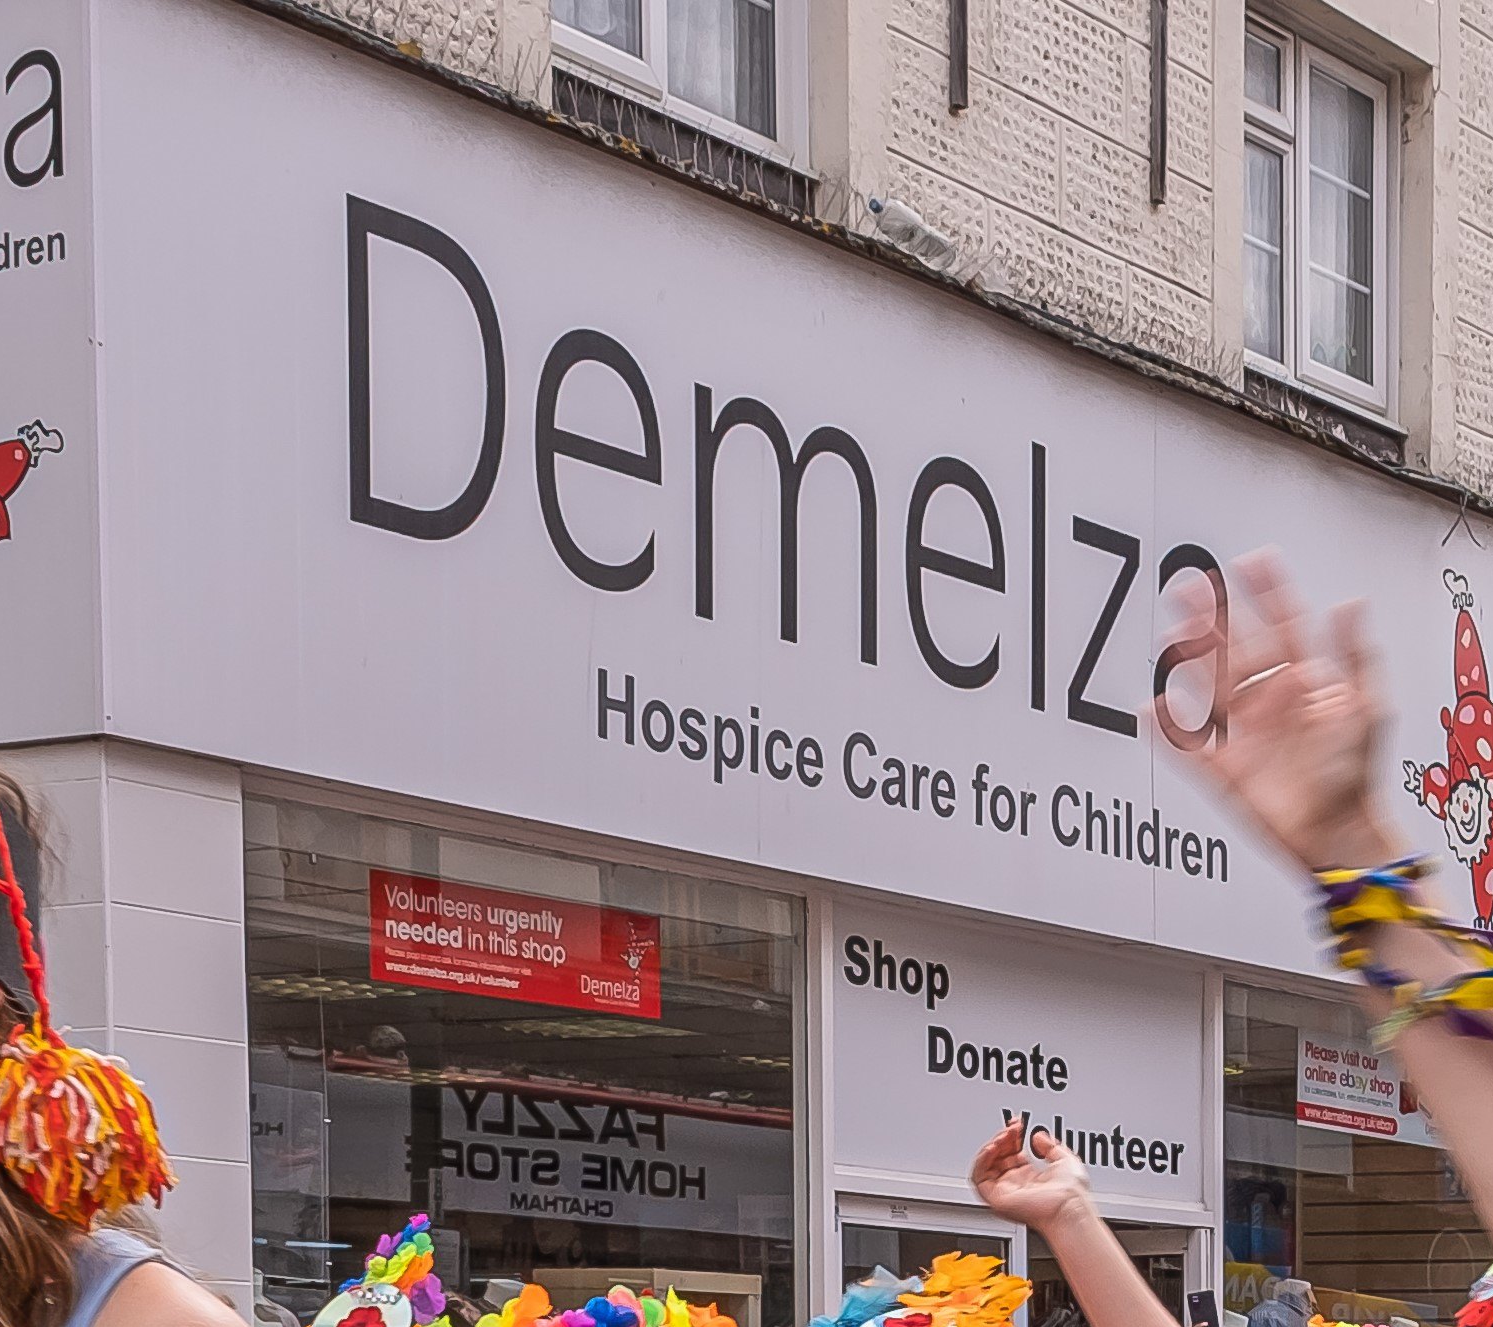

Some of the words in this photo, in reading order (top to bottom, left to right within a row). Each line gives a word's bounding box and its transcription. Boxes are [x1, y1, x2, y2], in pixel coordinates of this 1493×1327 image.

[345, 192, 1232, 756] Demelza
[595, 667, 823, 788] Hospice
[842, 729, 956, 818] Care
[972, 761, 1037, 837] for
[1052, 783, 1230, 883] Children
[384, 884, 482, 922] Volunteers
[487, 907, 563, 940] urgently
[385, 918, 462, 948] needed
[467, 927, 484, 946] in
[488, 930, 518, 957] this
[521, 936, 567, 967] shop
[580, 974, 641, 1002] Demelza
[843, 935, 951, 1009] Shop
[927, 1025, 1069, 1091] Donate
[1304, 1040, 1339, 1064] Please
[1341, 1049, 1360, 1068] visit
[1361, 1056, 1379, 1071] our
[1304, 1065, 1337, 1085] online
[1369, 1075, 1395, 1098] shop
[1001, 1108, 1185, 1176] Volunteer
